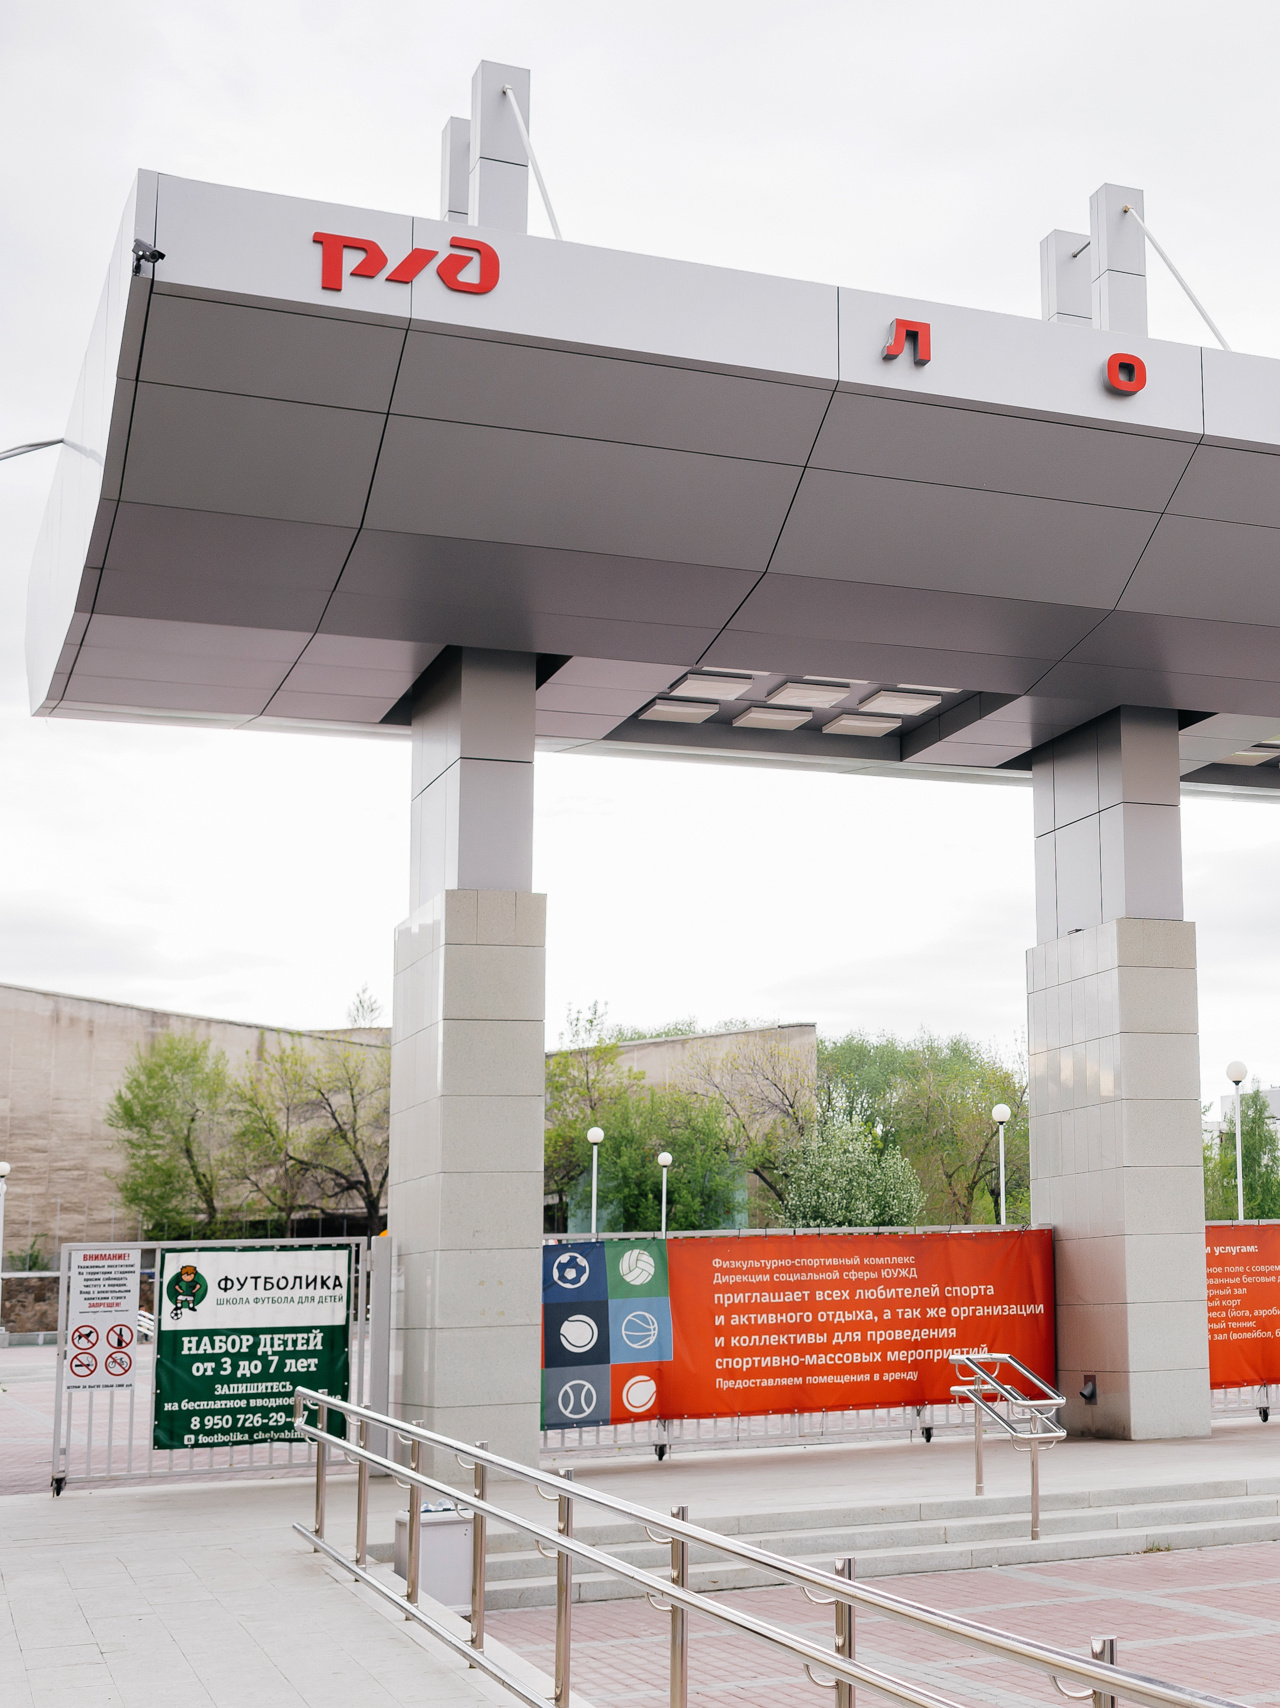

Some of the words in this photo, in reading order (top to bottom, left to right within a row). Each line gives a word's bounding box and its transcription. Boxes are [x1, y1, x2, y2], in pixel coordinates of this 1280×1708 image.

[83, 1253, 130, 1261] ВНИМАНИЕ!
[1214, 1245, 1258, 1255] услугам:
[712, 1256, 860, 1270] Физкультурно-спортивный
[864, 1256, 915, 1265] комплекс
[217, 1275, 343, 1293] ФУТБОЛИКА
[713, 1273, 770, 1285] Дирекции
[773, 1270, 839, 1282] социальной
[843, 1270, 878, 1281] сферы
[881, 1267, 917, 1279] ЮУЖД
[1242, 1275, 1276, 1283] беговые
[216, 1297, 250, 1305] ШКОЛА
[253, 1297, 295, 1305] ФУТБОЛА
[297, 1296, 315, 1305] ДЛЯ
[317, 1294, 343, 1305] ДЕТЕЙ
[714, 1291, 810, 1307] приглашает
[816, 1290, 849, 1301] всех
[855, 1284, 940, 1300] любителей
[944, 1285, 994, 1299] спорта
[1222, 1299, 1241, 1308] корт
[714, 1315, 725, 1326] и
[731, 1312, 813, 1325] активного
[818, 1310, 878, 1324] отдыха,
[883, 1310, 891, 1320] а
[896, 1308, 921, 1319] так
[926, 1307, 947, 1318] же
[951, 1304, 1044, 1320] организации
[1228, 1309, 1252, 1318] (йога,
[181, 1334, 254, 1354] НАБОР
[257, 1329, 323, 1355] ДЕТЕЙ
[714, 1336, 725, 1347] и
[731, 1332, 827, 1347] коллективы
[832, 1331, 861, 1345] для
[867, 1328, 957, 1344] проведения
[1230, 1329, 1274, 1340] (волейбол,
[715, 1351, 881, 1371] спортивно-массовых
[887, 1344, 988, 1364] мероприятий
[192, 1362, 215, 1376] от
[220, 1357, 232, 1375] 3
[237, 1360, 262, 1377] до
[268, 1356, 279, 1373] 7
[284, 1358, 319, 1373] лет
[215, 1382, 293, 1395] ЗАПИШИТЕСЬ
[716, 1376, 802, 1390] Предоставляем
[806, 1373, 870, 1384] помещения
[874, 1373, 879, 1381] в
[883, 1371, 918, 1381] аренду
[164, 1401, 179, 1411] на
[181, 1399, 247, 1410] бесплатное
[250, 1397, 295, 1408] вводное
[190, 1416, 200, 1430] 8
[204, 1415, 232, 1429] 950
[236, 1411, 308, 1428] 726-29-7
